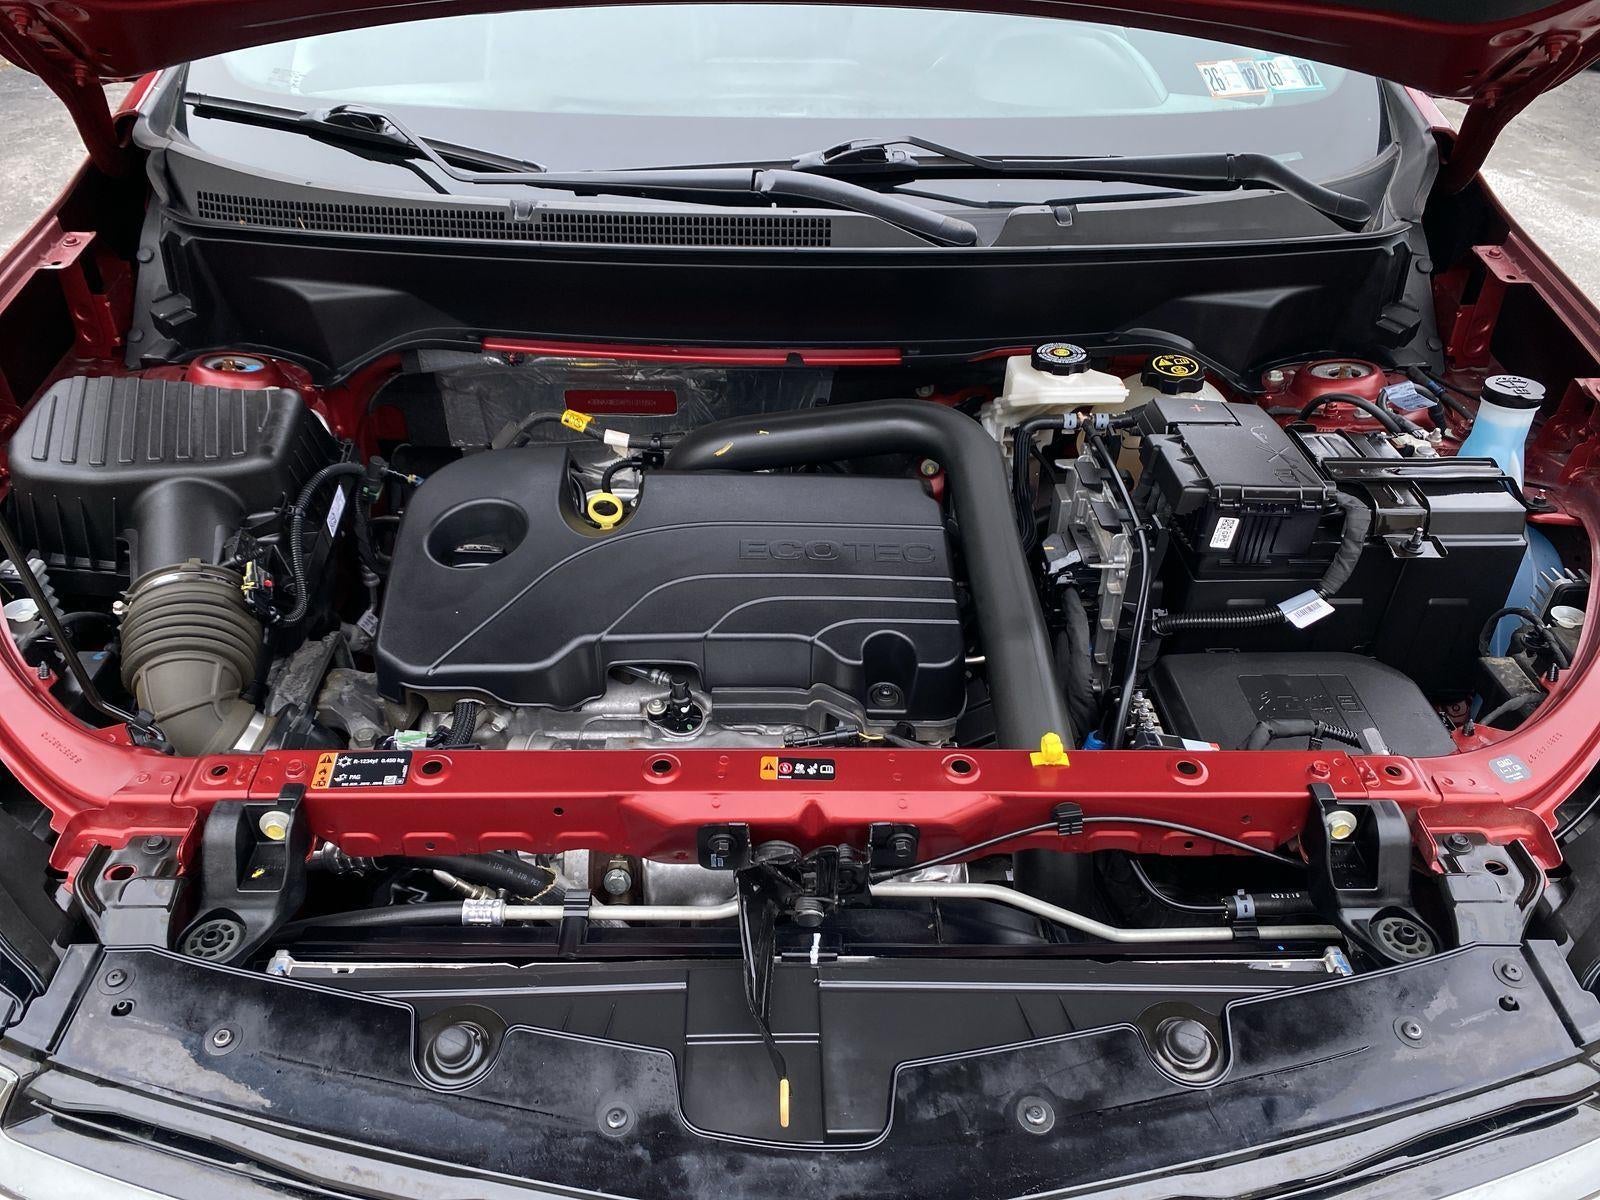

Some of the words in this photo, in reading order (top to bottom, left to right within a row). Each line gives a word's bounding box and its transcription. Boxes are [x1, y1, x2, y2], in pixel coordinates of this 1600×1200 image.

[1203, 66, 1226, 92] 26
[1241, 67, 1264, 90] 12
[1260, 61, 1283, 87] 26
[1297, 63, 1320, 86] 12
[738, 539, 936, 564] ECOTEC
